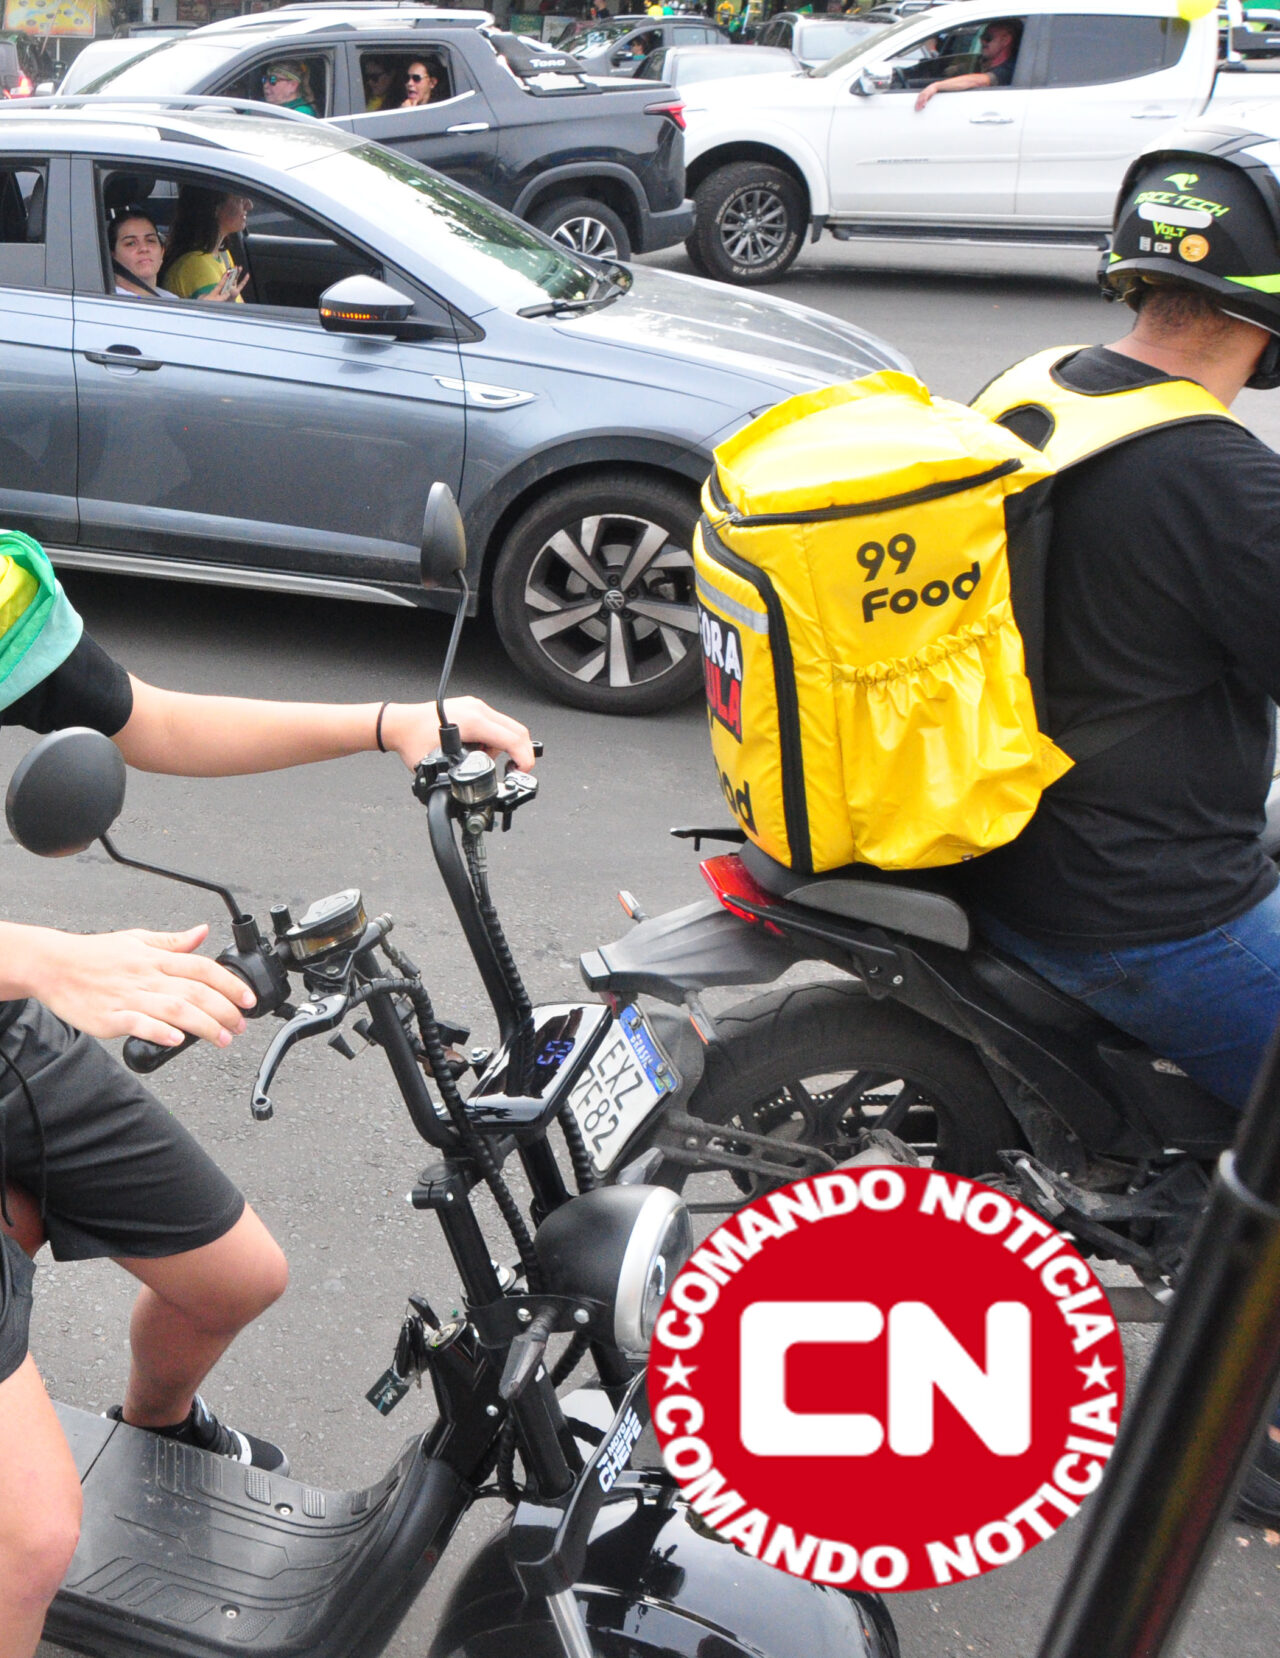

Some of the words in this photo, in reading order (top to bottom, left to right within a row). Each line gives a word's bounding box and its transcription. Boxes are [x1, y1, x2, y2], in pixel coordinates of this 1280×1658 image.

[529, 58, 566, 68] TORO
[1174, 193, 1231, 217] TECH
[1152, 220, 1187, 238] VOLT
[855, 533, 916, 582] 99
[861, 561, 982, 623] Food
[697, 602, 741, 682] ORA
[629, 1033, 654, 1069] BRASIL
[598, 1411, 642, 1493] CHEFE
[607, 1421, 627, 1457] MOTO
